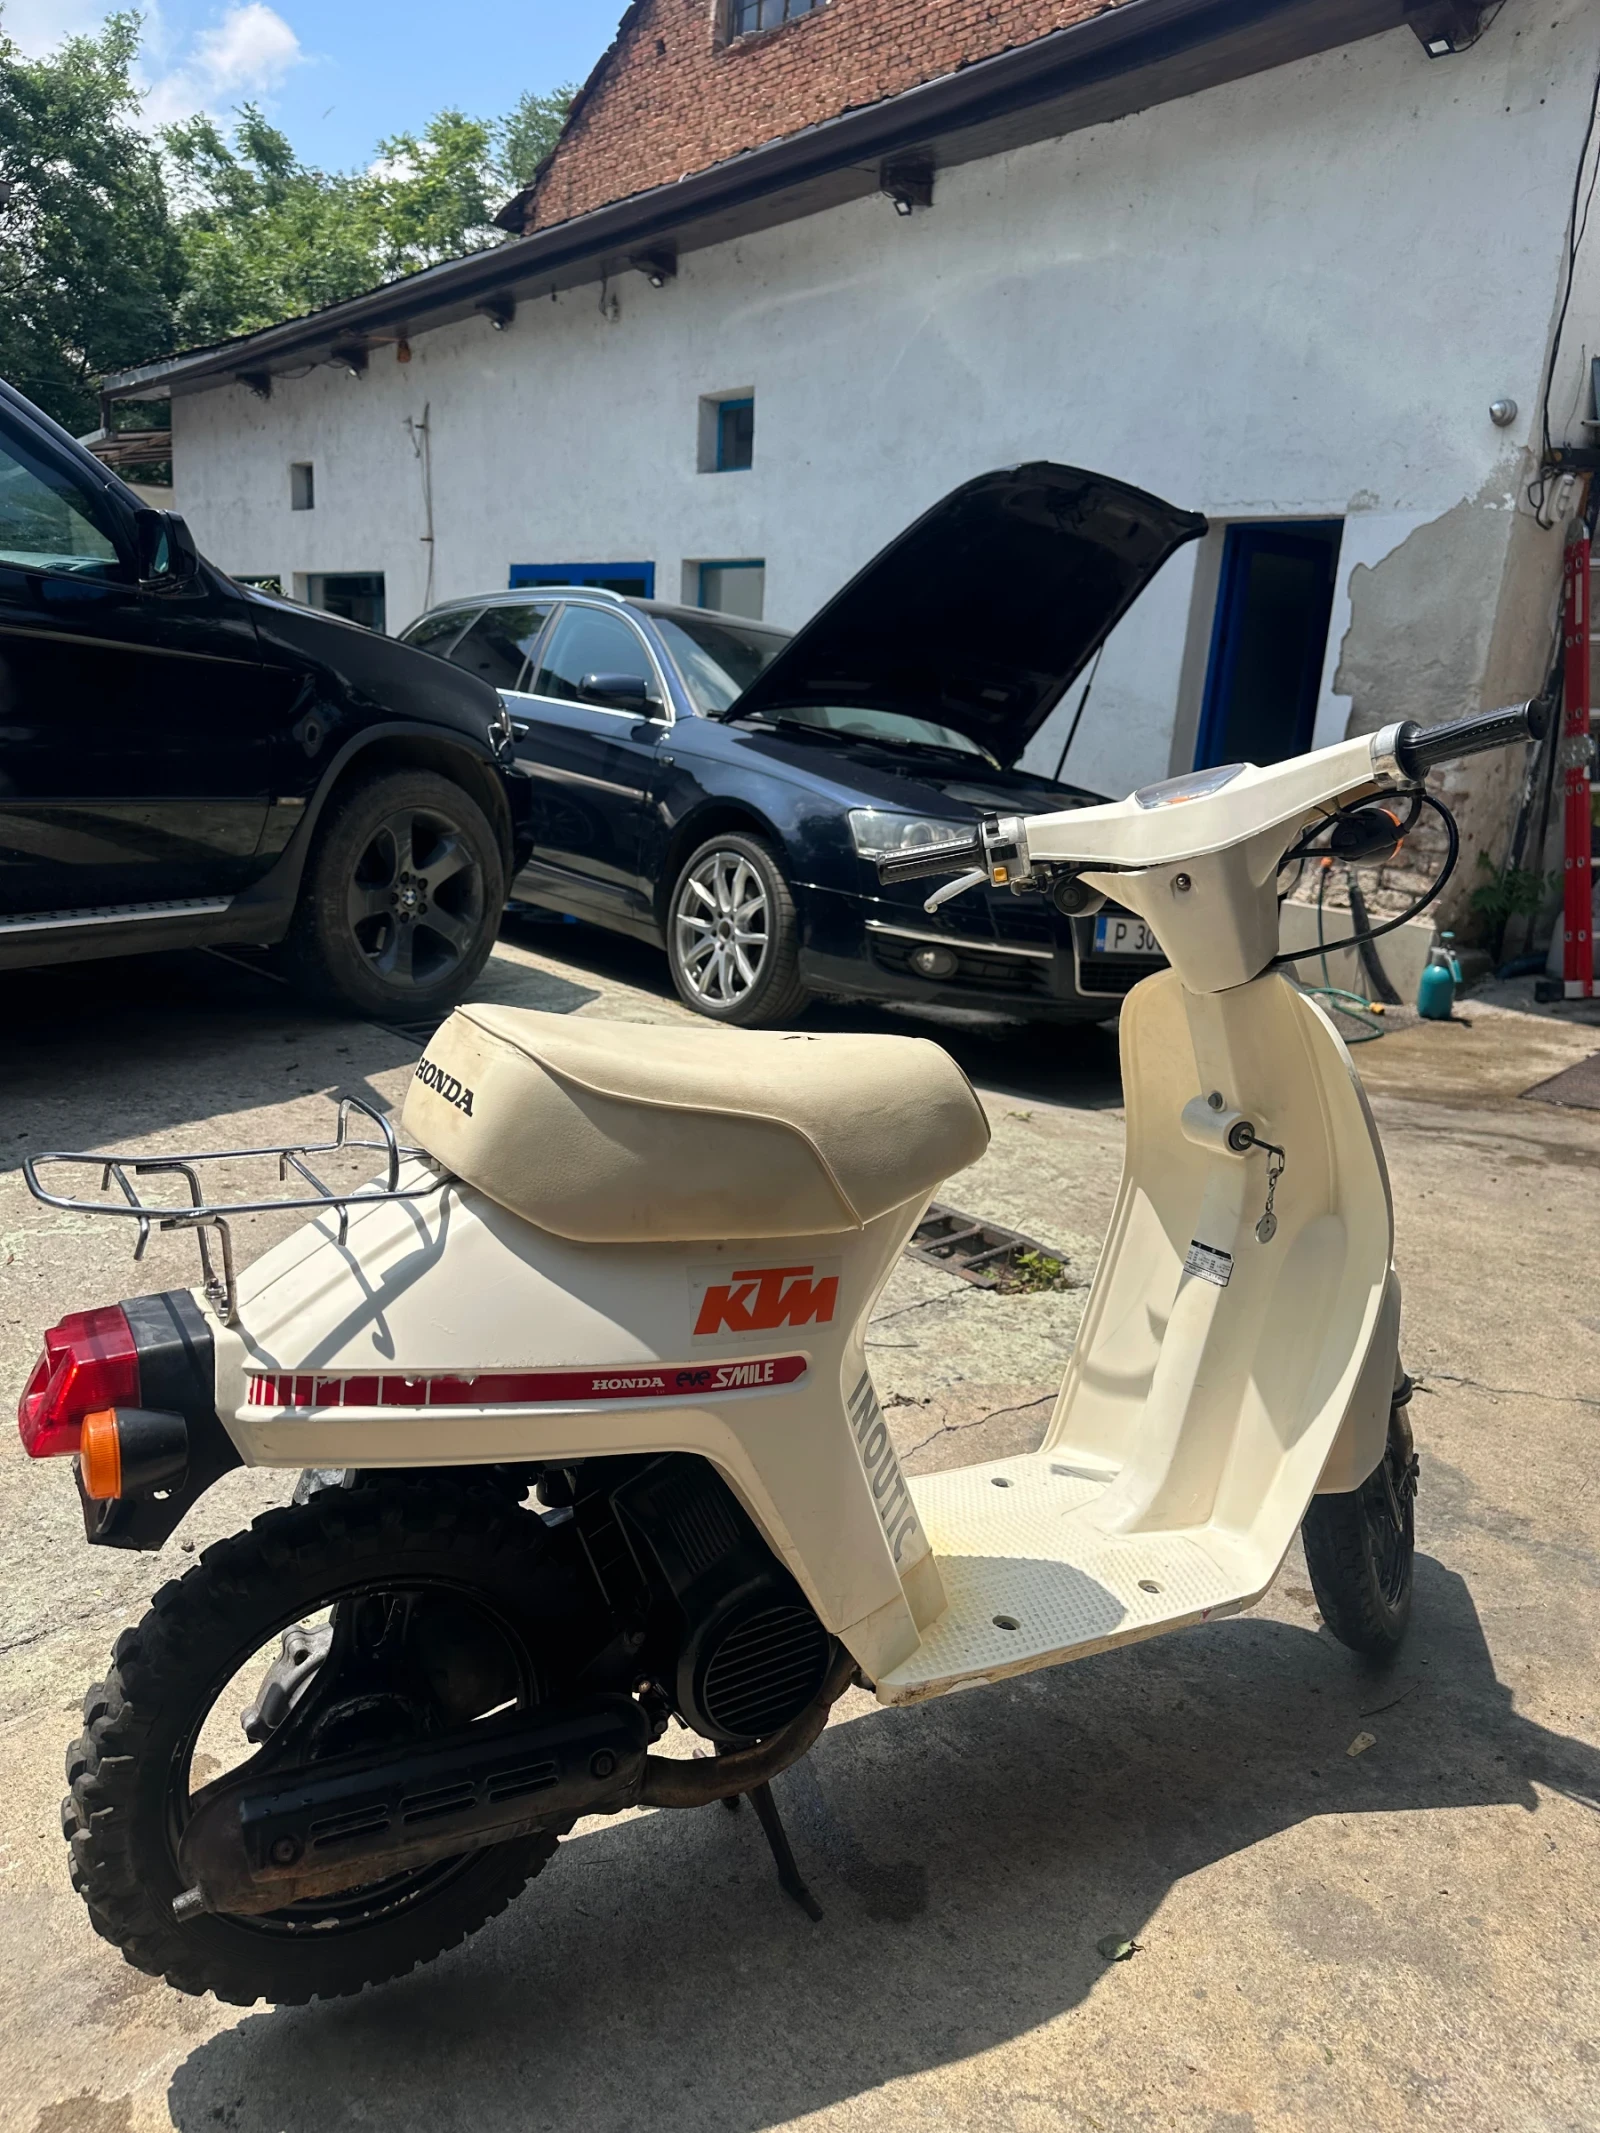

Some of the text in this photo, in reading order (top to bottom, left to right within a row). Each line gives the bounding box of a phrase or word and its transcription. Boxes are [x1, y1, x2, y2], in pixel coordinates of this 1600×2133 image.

[1114, 922, 1163, 951] P 30
[415, 1057, 474, 1118] HONDA
[693, 1265, 840, 1336] KTM
[591, 1362, 775, 1391] HONDA eve SMILE
[847, 1369, 918, 1564] INOUTIC
